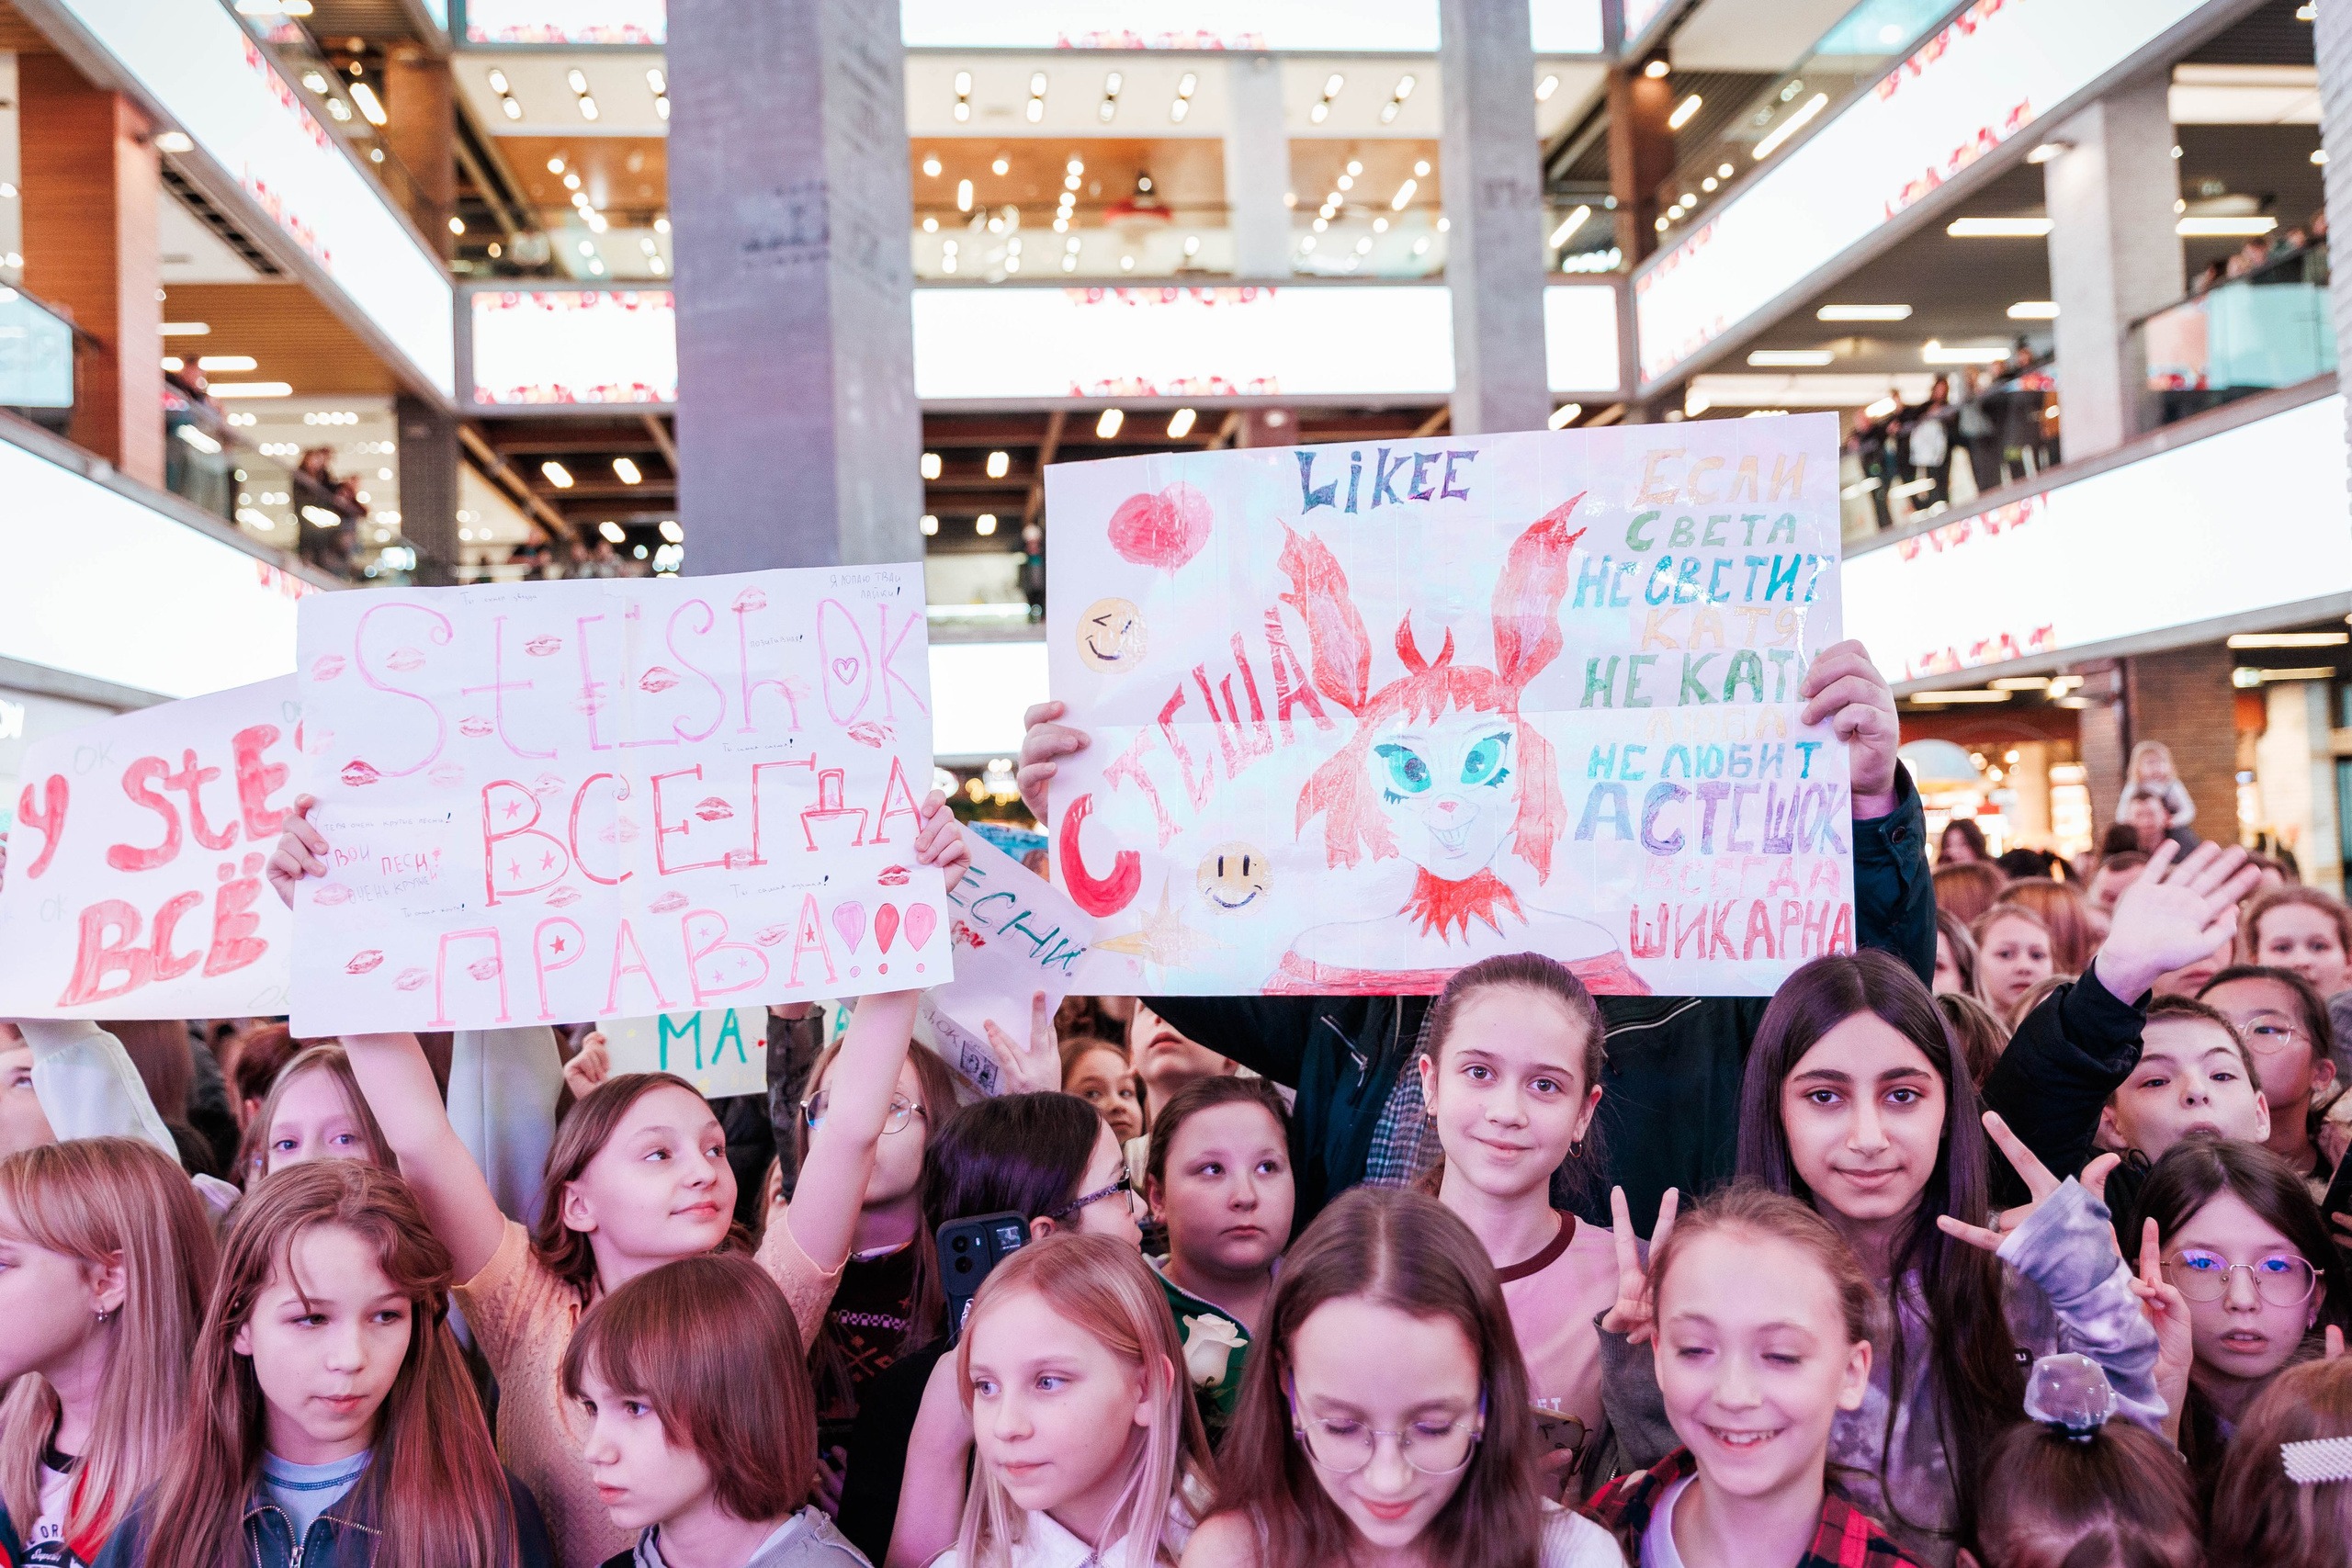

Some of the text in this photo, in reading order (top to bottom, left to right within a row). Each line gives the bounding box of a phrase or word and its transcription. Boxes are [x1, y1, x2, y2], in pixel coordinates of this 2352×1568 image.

[1633, 448, 1807, 507] ЕСЛИ
[1625, 511, 1797, 551] СВЕТА
[1579, 649, 1823, 708] НЕ КАТ
[1588, 741, 1823, 780] НЕ ЛЮБИТ
[326, 844, 371, 871] ВОИ
[481, 752, 924, 908] ВСЕГДА
[1643, 856, 1840, 897] ВСЕГДА
[55, 852, 269, 1009] ВСЁ
[1629, 898, 1854, 961] ШИКАРНА
